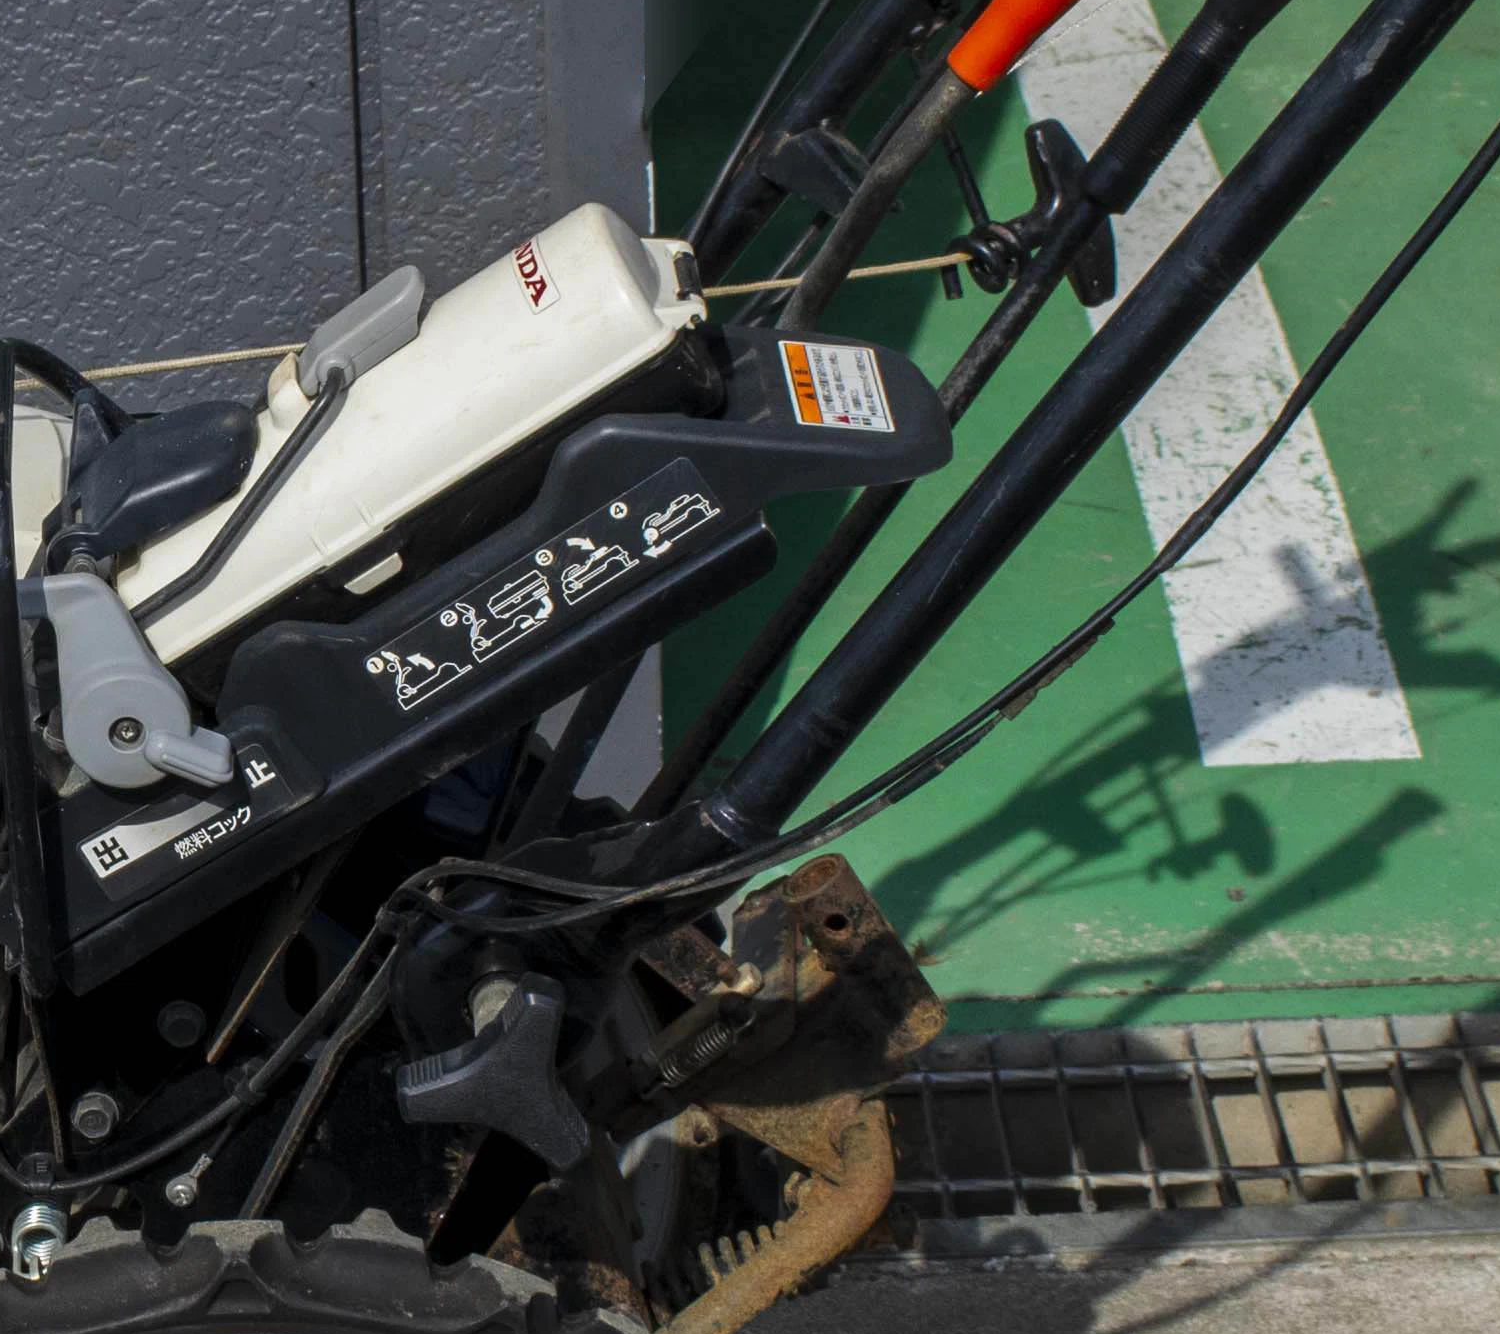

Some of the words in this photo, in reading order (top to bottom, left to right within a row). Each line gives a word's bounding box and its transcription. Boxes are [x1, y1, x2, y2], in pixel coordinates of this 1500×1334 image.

[244, 759, 277, 789] 止
[173, 805, 252, 860] 燃料コック
[92, 835, 130, 871] 出
